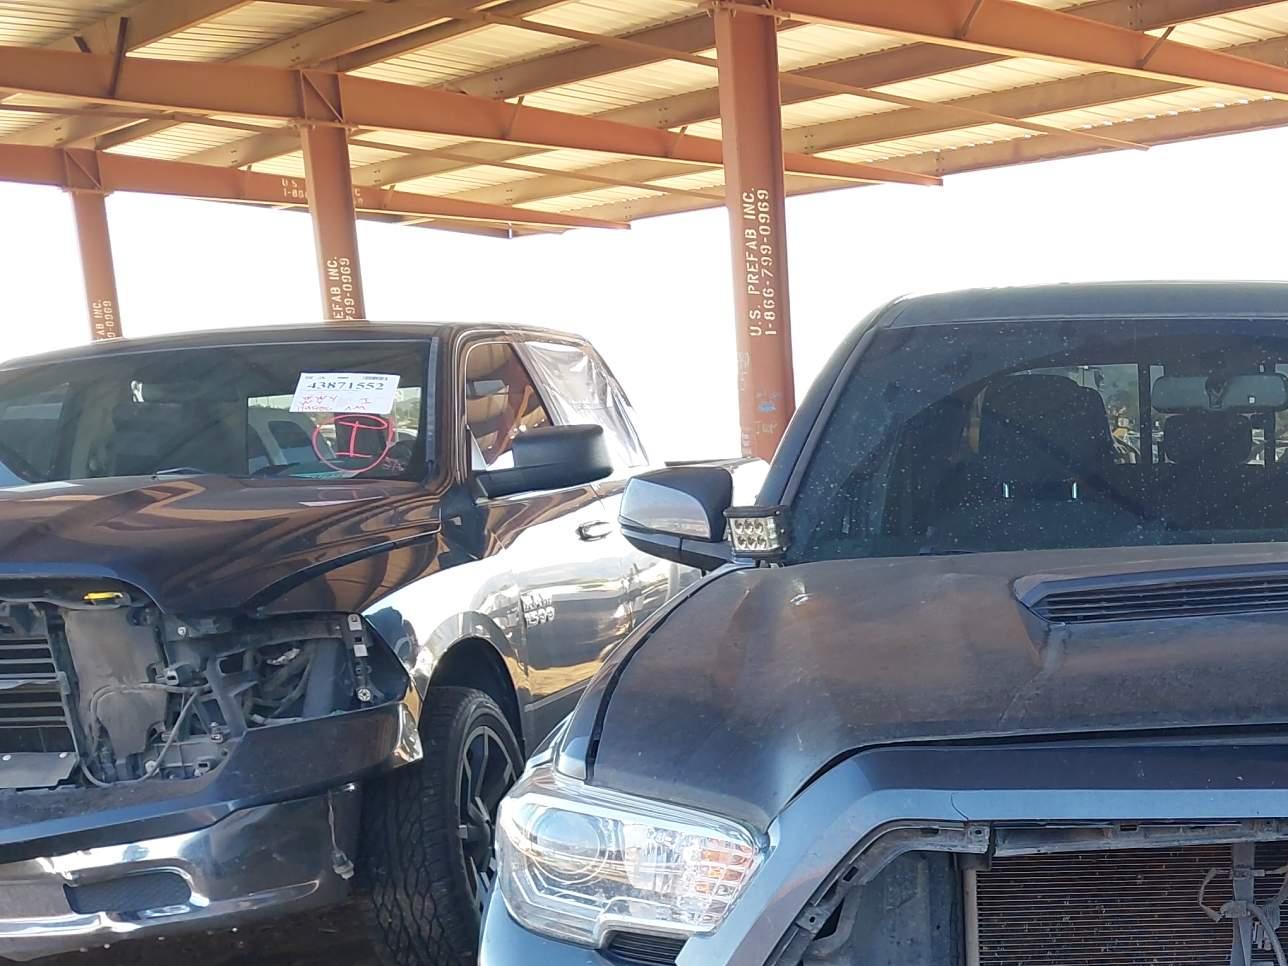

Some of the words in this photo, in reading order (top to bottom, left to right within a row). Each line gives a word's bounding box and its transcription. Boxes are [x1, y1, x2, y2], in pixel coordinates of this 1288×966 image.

[742, 187, 755, 220] INC.
[326, 256, 340, 281] INC.
[745, 230, 761, 295] PREFAB
[757, 189, 777, 335] 1-866-799-0969
[330, 287, 345, 320] EFAB
[748, 305, 763, 337] U.S.
[306, 381, 385, 391] 43871552
